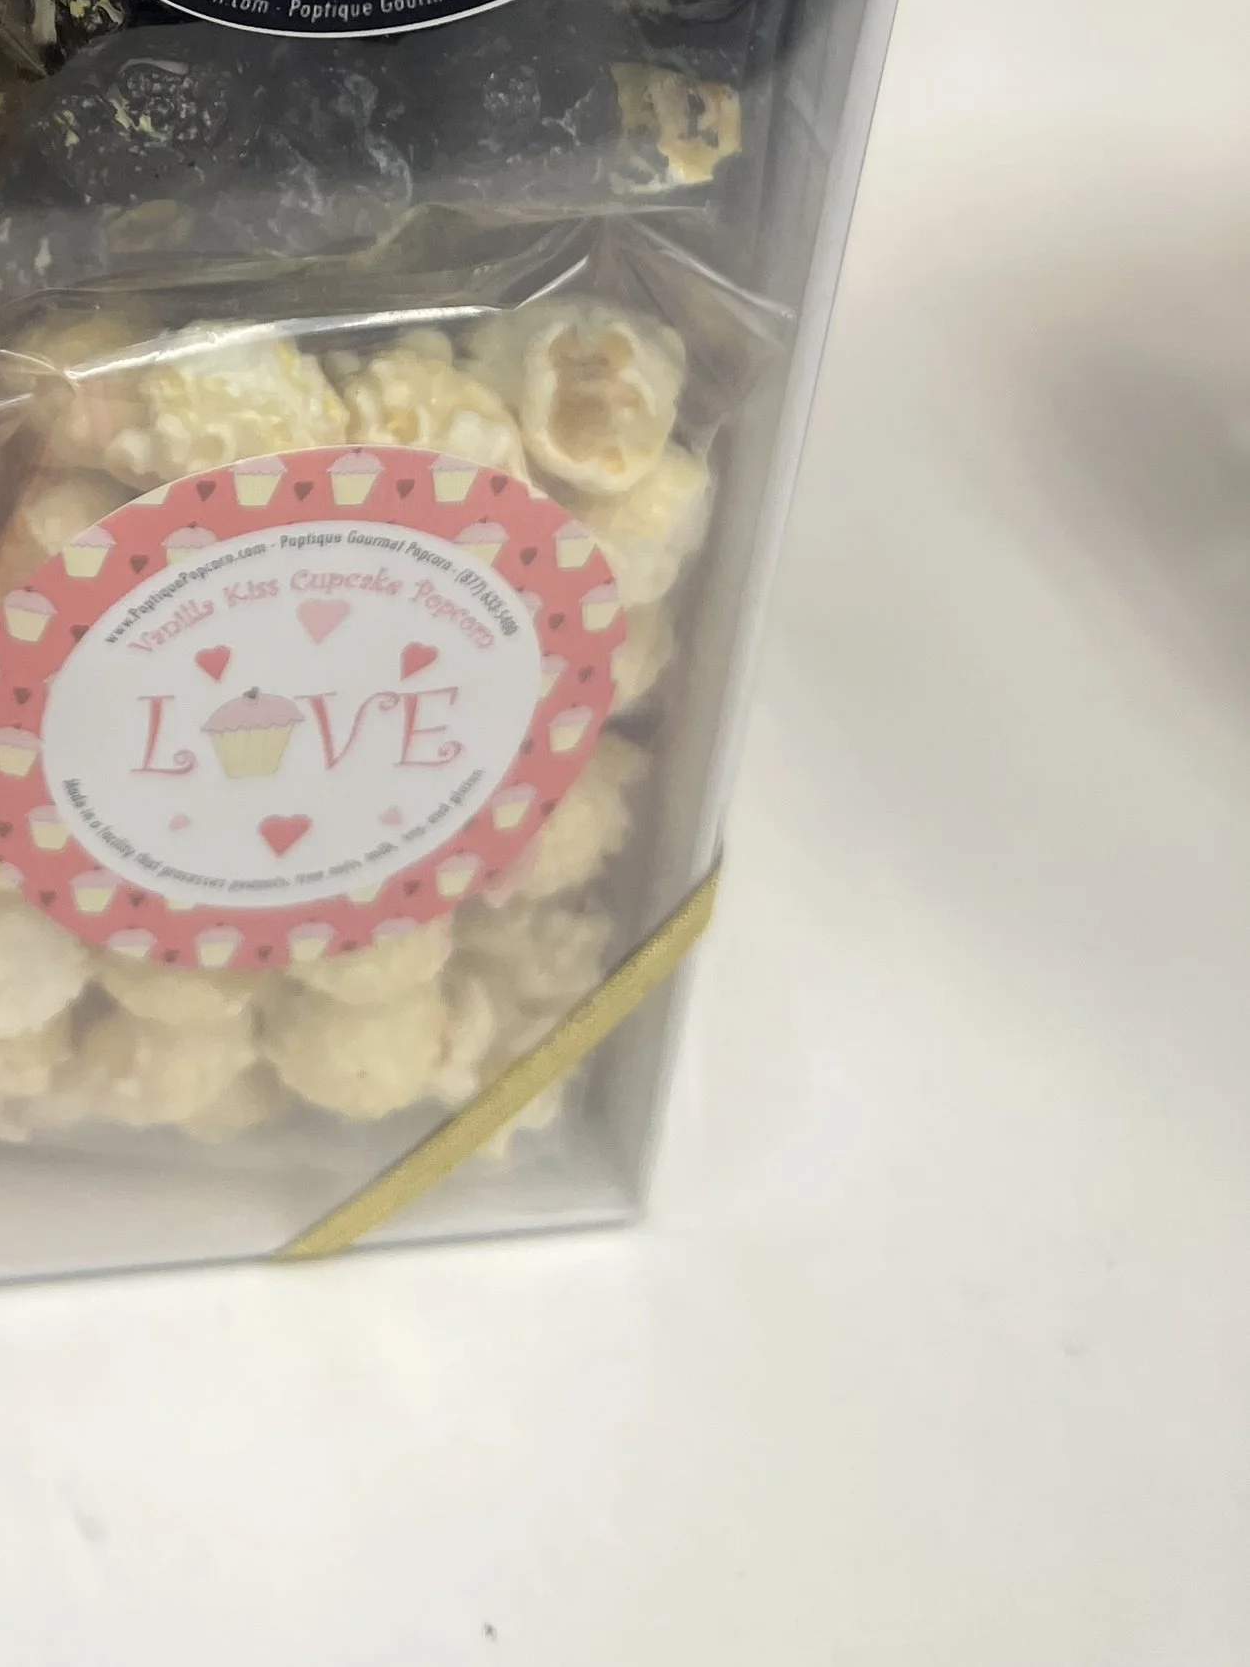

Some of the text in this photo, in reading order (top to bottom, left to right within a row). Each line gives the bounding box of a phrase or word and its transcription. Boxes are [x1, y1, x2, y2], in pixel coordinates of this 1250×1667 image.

[280, 531, 343, 550] Poptique
[347, 530, 406, 553] Gourmet
[127, 566, 495, 652] Vanilla Kiss Cupcake Popcorn
